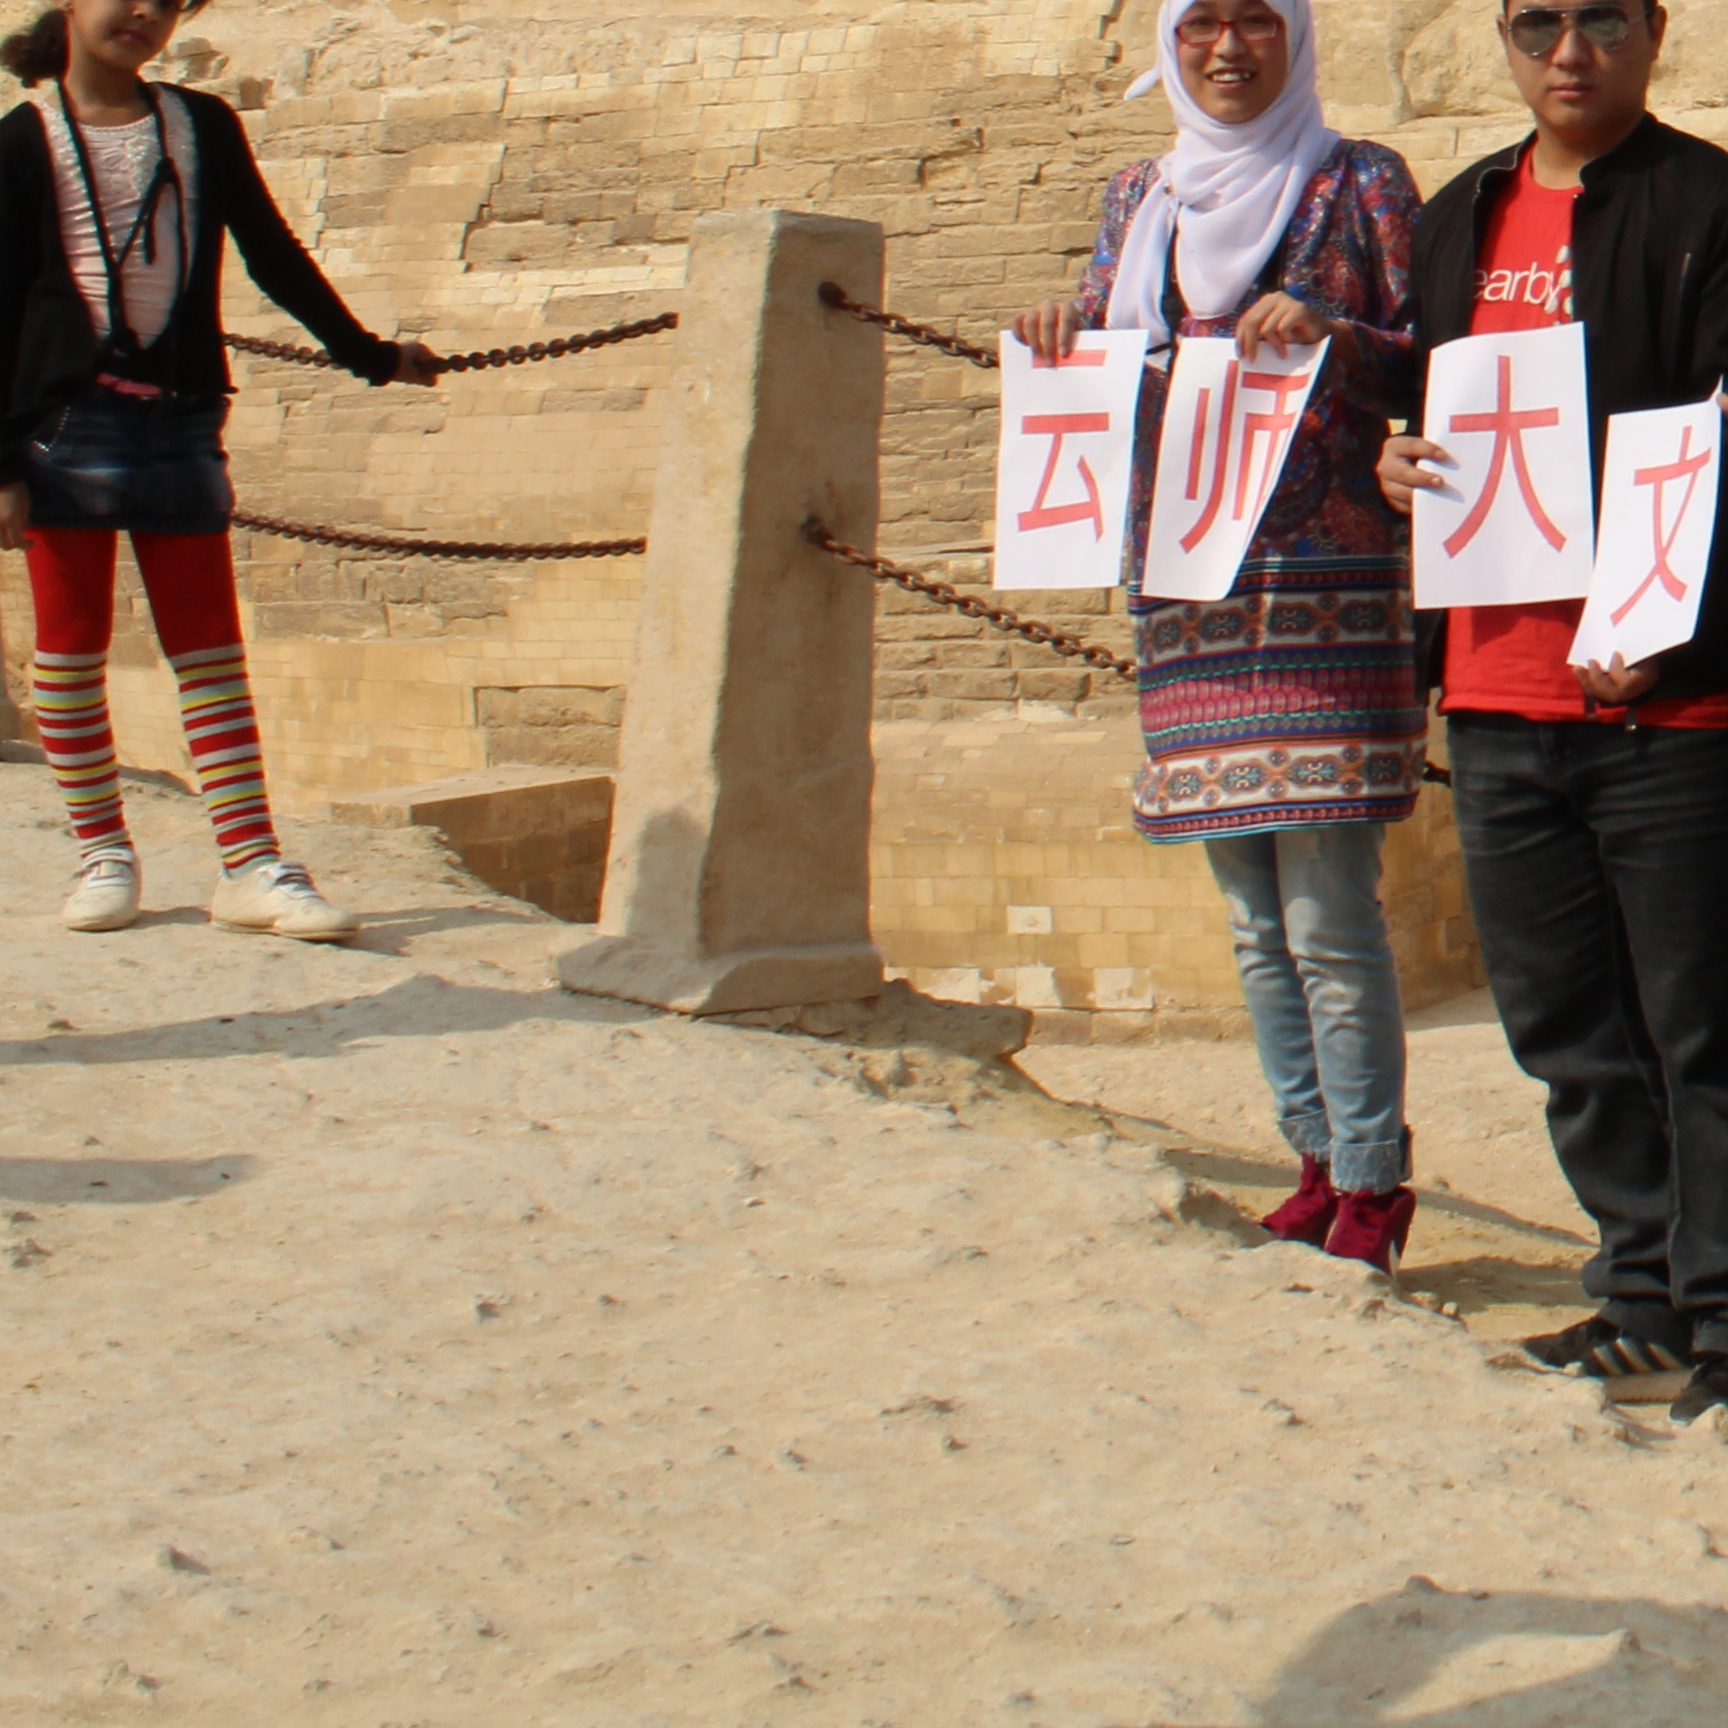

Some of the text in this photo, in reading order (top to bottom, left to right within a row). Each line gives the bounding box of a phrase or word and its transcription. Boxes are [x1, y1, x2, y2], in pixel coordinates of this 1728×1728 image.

[1017, 348, 1109, 541] 云
[1179, 359, 1311, 554] 师
[1444, 355, 1567, 558] 大
[1611, 425, 1712, 626] 文
